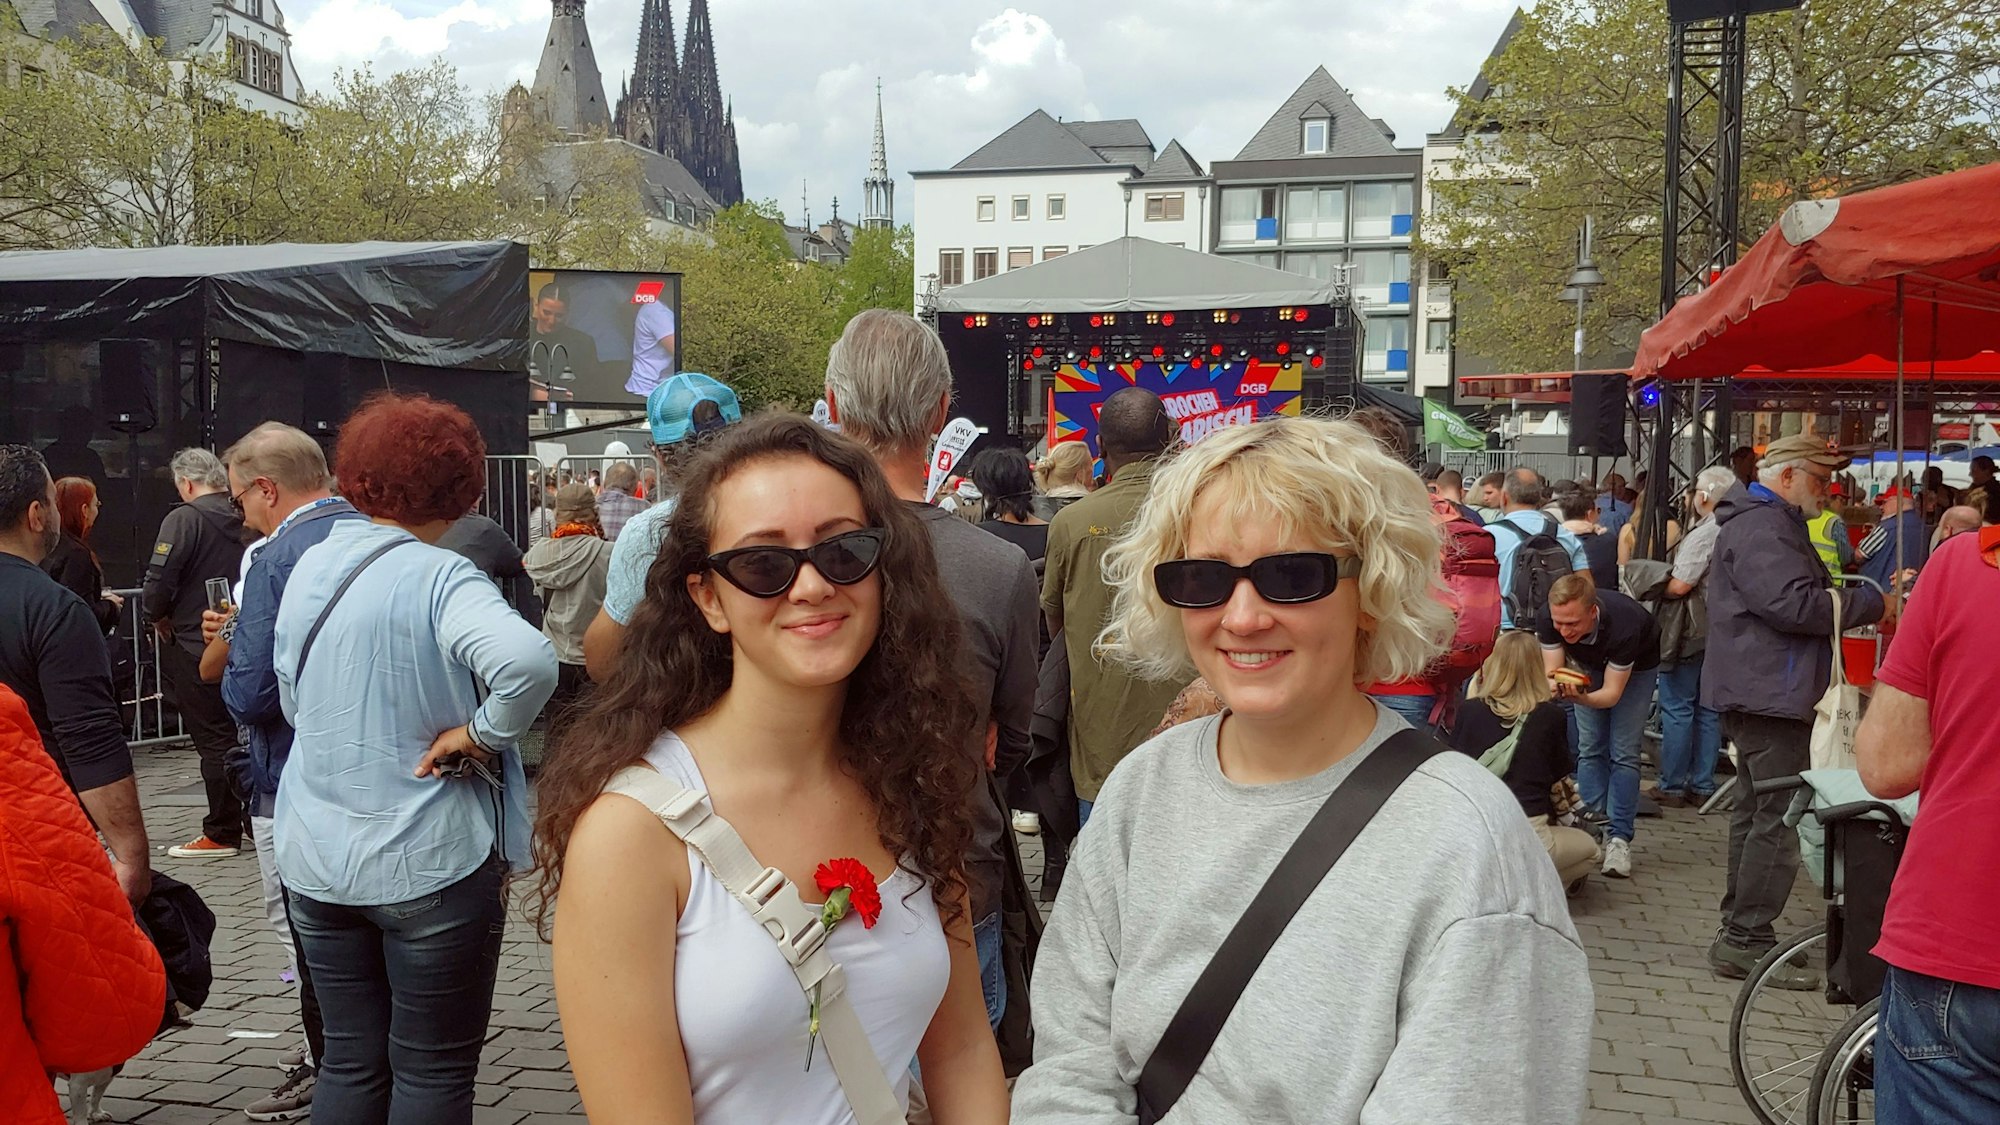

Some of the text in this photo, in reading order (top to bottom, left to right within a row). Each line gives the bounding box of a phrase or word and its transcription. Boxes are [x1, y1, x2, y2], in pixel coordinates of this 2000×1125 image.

[635, 294, 655, 303] DGB
[1240, 383, 1267, 394] DGB
[1161, 391, 1220, 419] ROCHEN
[955, 425, 972, 437] VKV
